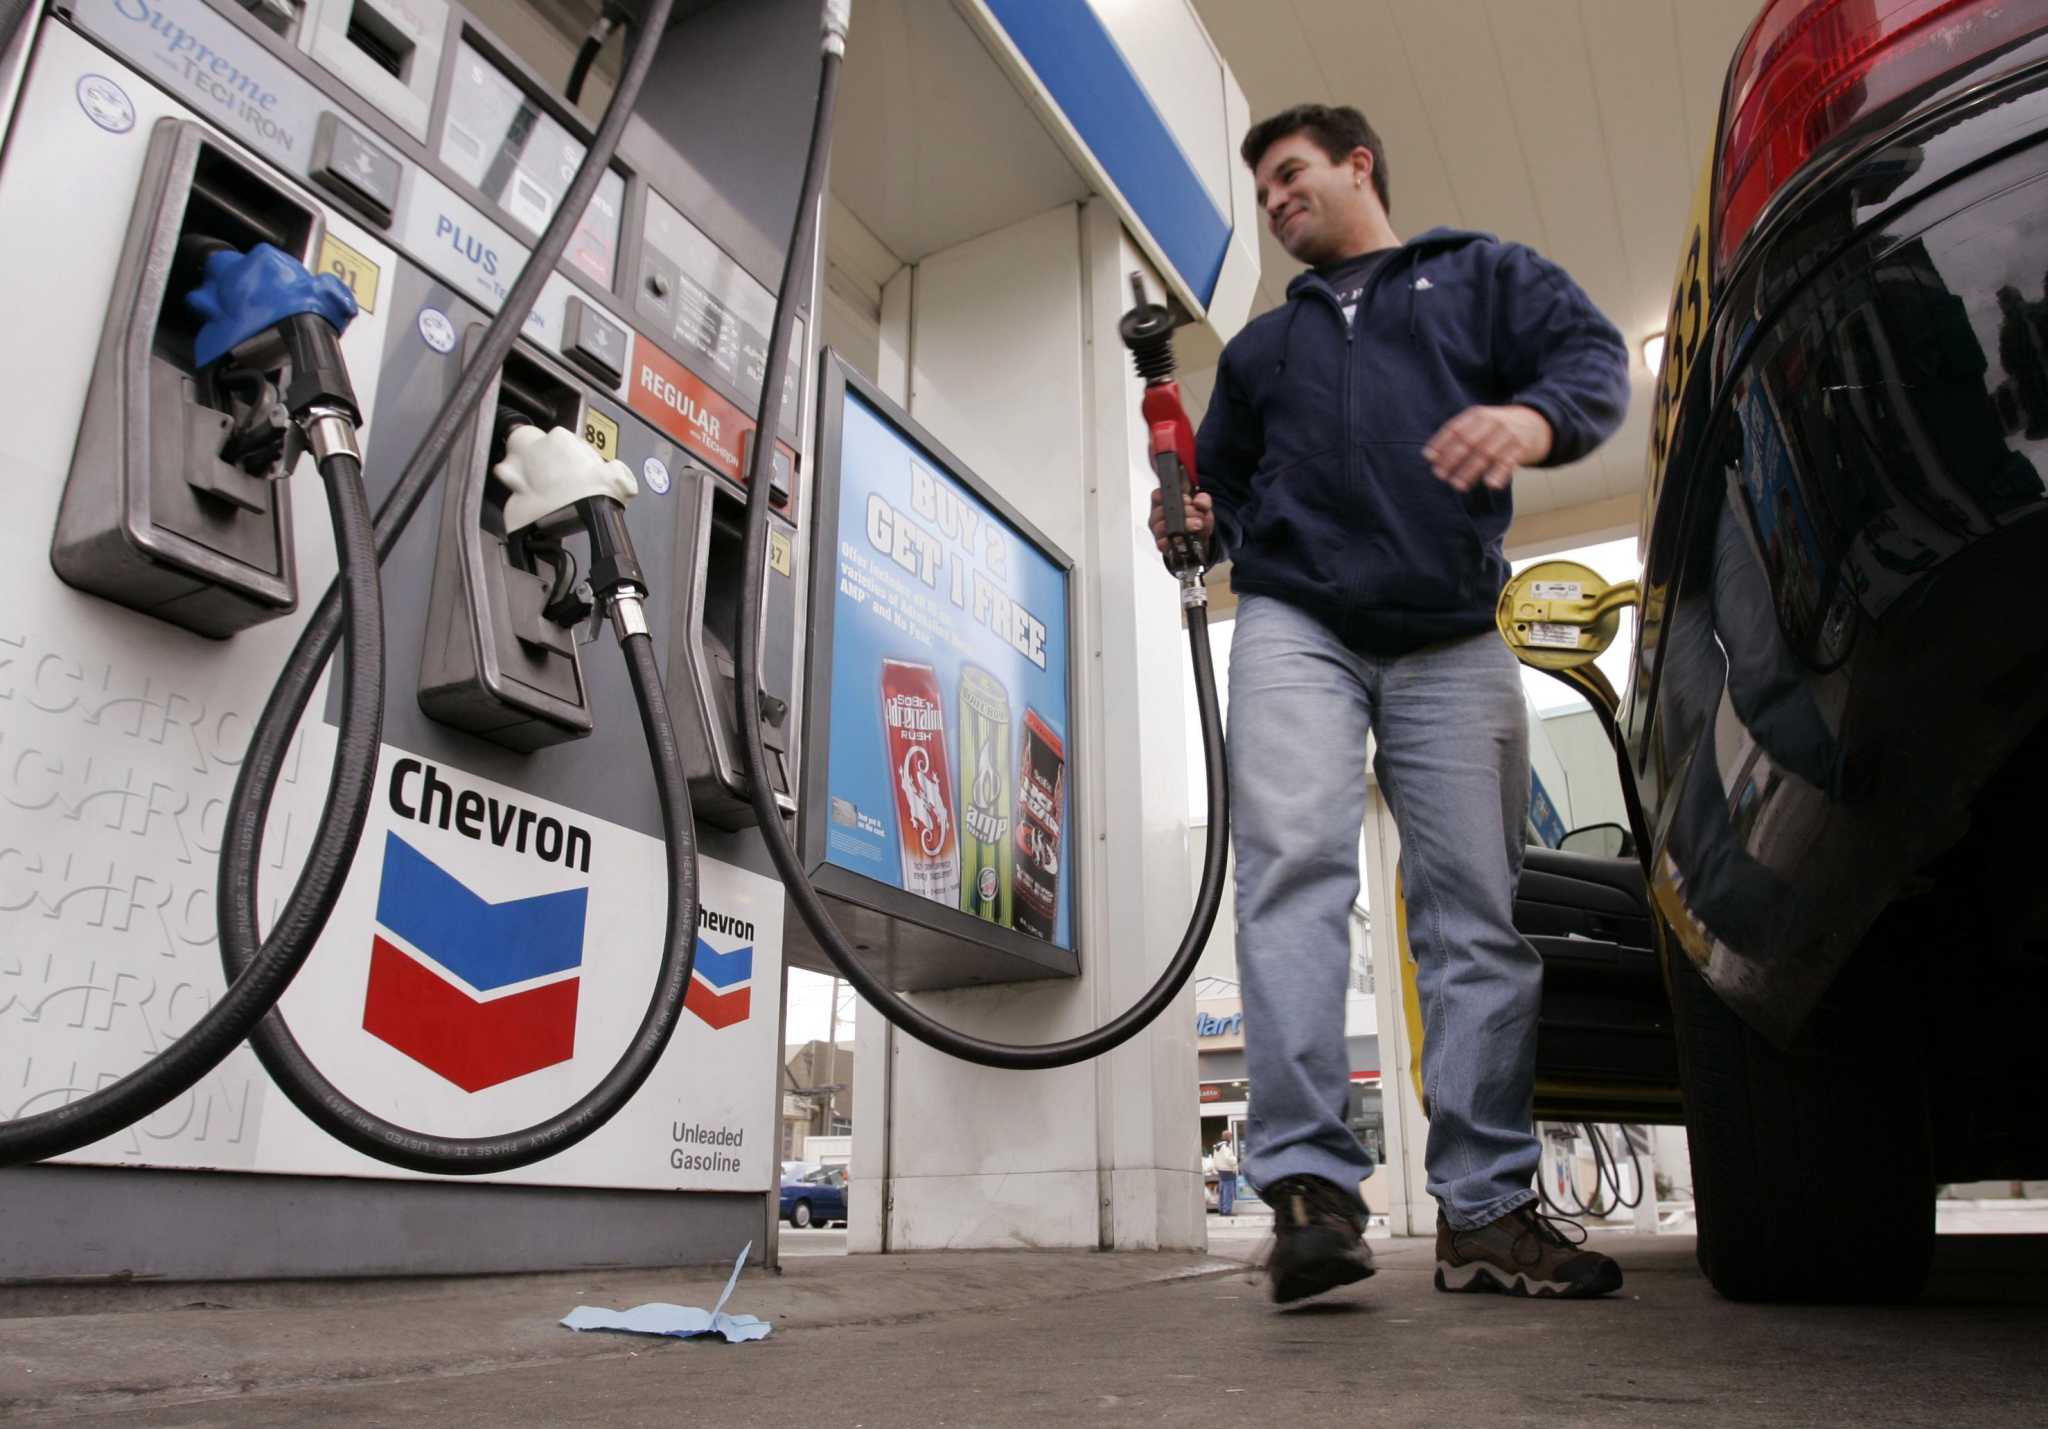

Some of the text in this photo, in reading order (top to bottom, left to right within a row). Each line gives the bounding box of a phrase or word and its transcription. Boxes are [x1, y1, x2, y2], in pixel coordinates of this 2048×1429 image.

[114, 0, 278, 111] Supreme
[181, 54, 294, 150] TECHRON
[436, 214, 498, 276] PLUS
[332, 260, 358, 294] 91
[641, 364, 722, 439] REGULAR
[585, 424, 606, 450] 89
[910, 457, 1008, 583] BUY 2
[866, 491, 943, 590] GET
[972, 567, 1047, 673] FREE
[389, 757, 592, 873] Chevron
[697, 903, 754, 942] hevron
[1196, 1011, 1243, 1036] art
[385, 1130, 430, 1153] LISTED
[481, 1139, 519, 1158] PHASE
[673, 1121, 743, 1147] Unleaded
[670, 1148, 741, 1173] Gasoline
